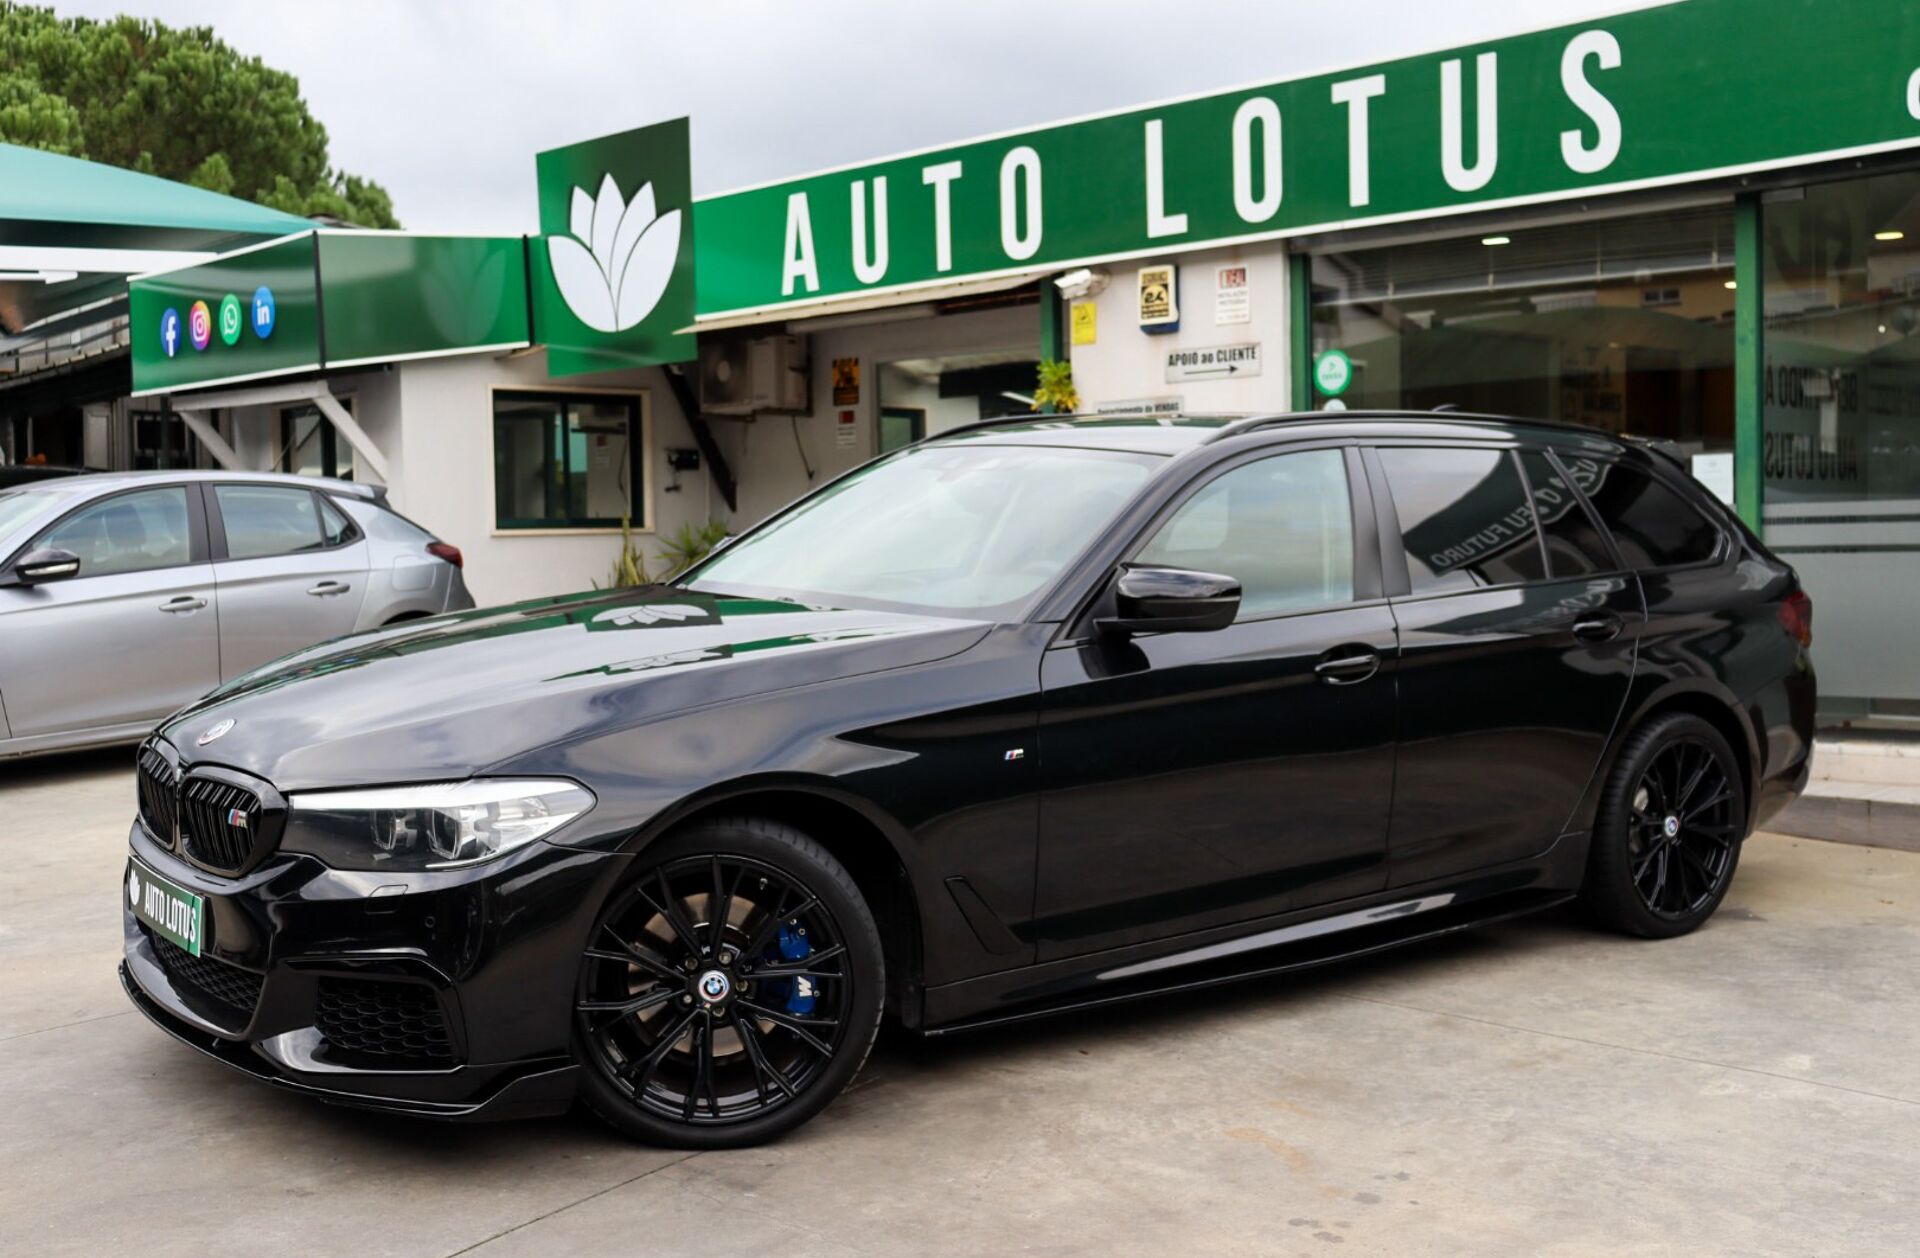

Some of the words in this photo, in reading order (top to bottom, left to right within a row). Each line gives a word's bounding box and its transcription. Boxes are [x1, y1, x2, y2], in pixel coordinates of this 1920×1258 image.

[783, 147, 1042, 296] AUTO
[1146, 30, 1622, 238] LOTUS
[256, 299, 270, 326] in
[1168, 352, 1198, 367] APOIO
[1201, 352, 1213, 364] ao
[1216, 346, 1256, 363] CLIENTE
[144, 881, 165, 925] AUTO
[166, 894, 197, 943] LOTUS
